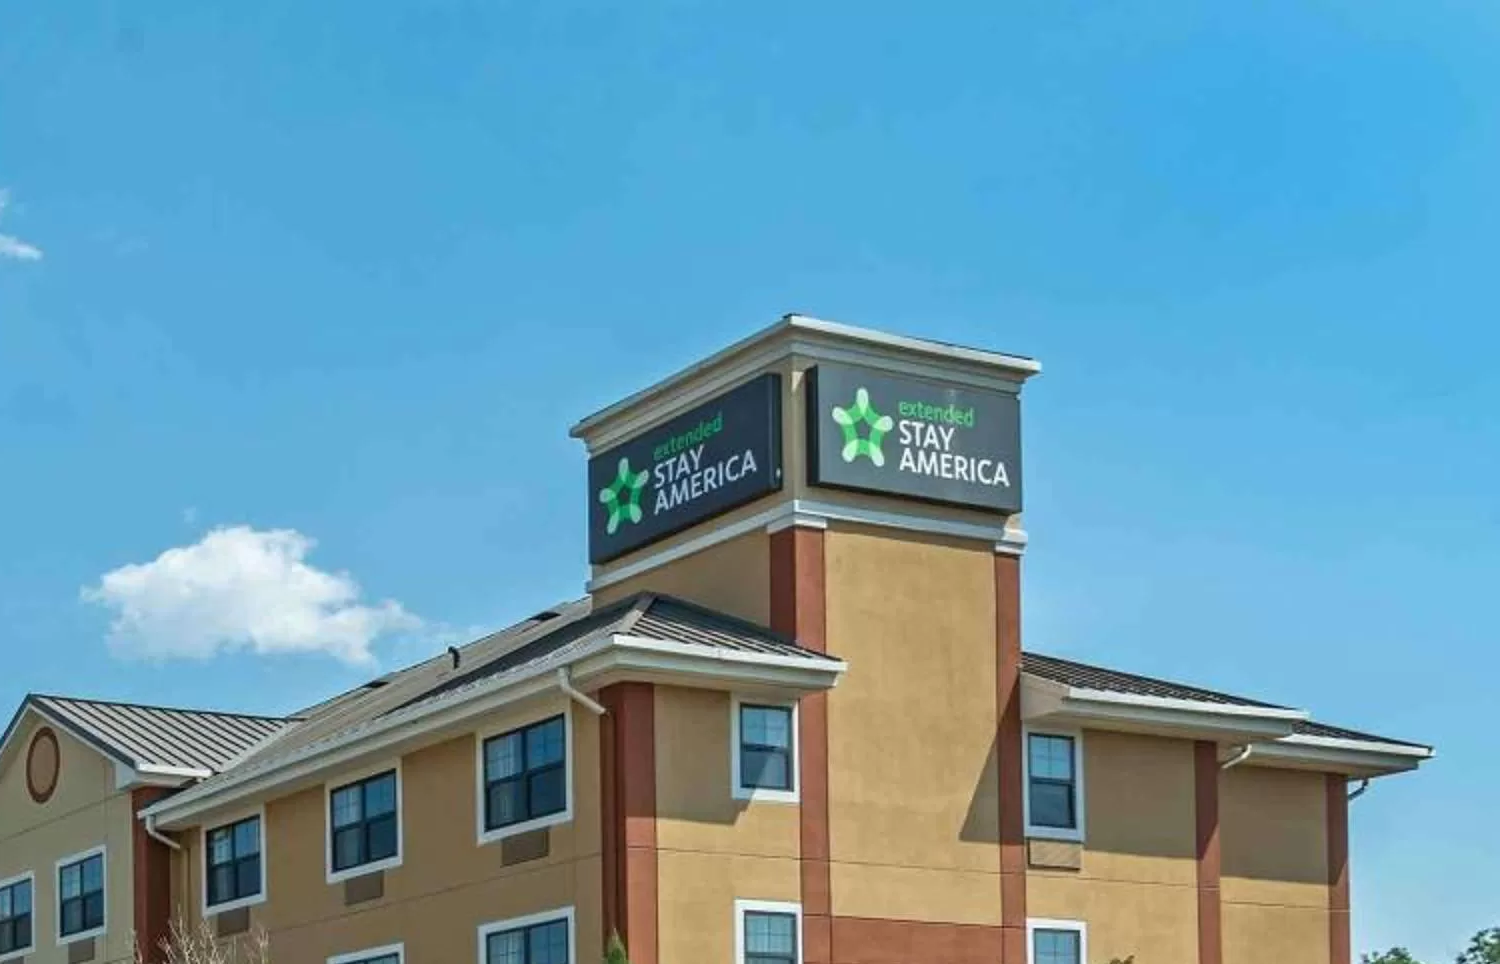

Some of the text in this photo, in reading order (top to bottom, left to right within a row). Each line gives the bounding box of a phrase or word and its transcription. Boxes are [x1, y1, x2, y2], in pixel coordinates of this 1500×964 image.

[899, 400, 974, 427] extended
[653, 411, 724, 461] extended
[899, 419, 955, 451] STAY
[654, 444, 705, 489] STAY
[654, 449, 757, 515] AMERICA
[899, 447, 1010, 487] AMERICA
